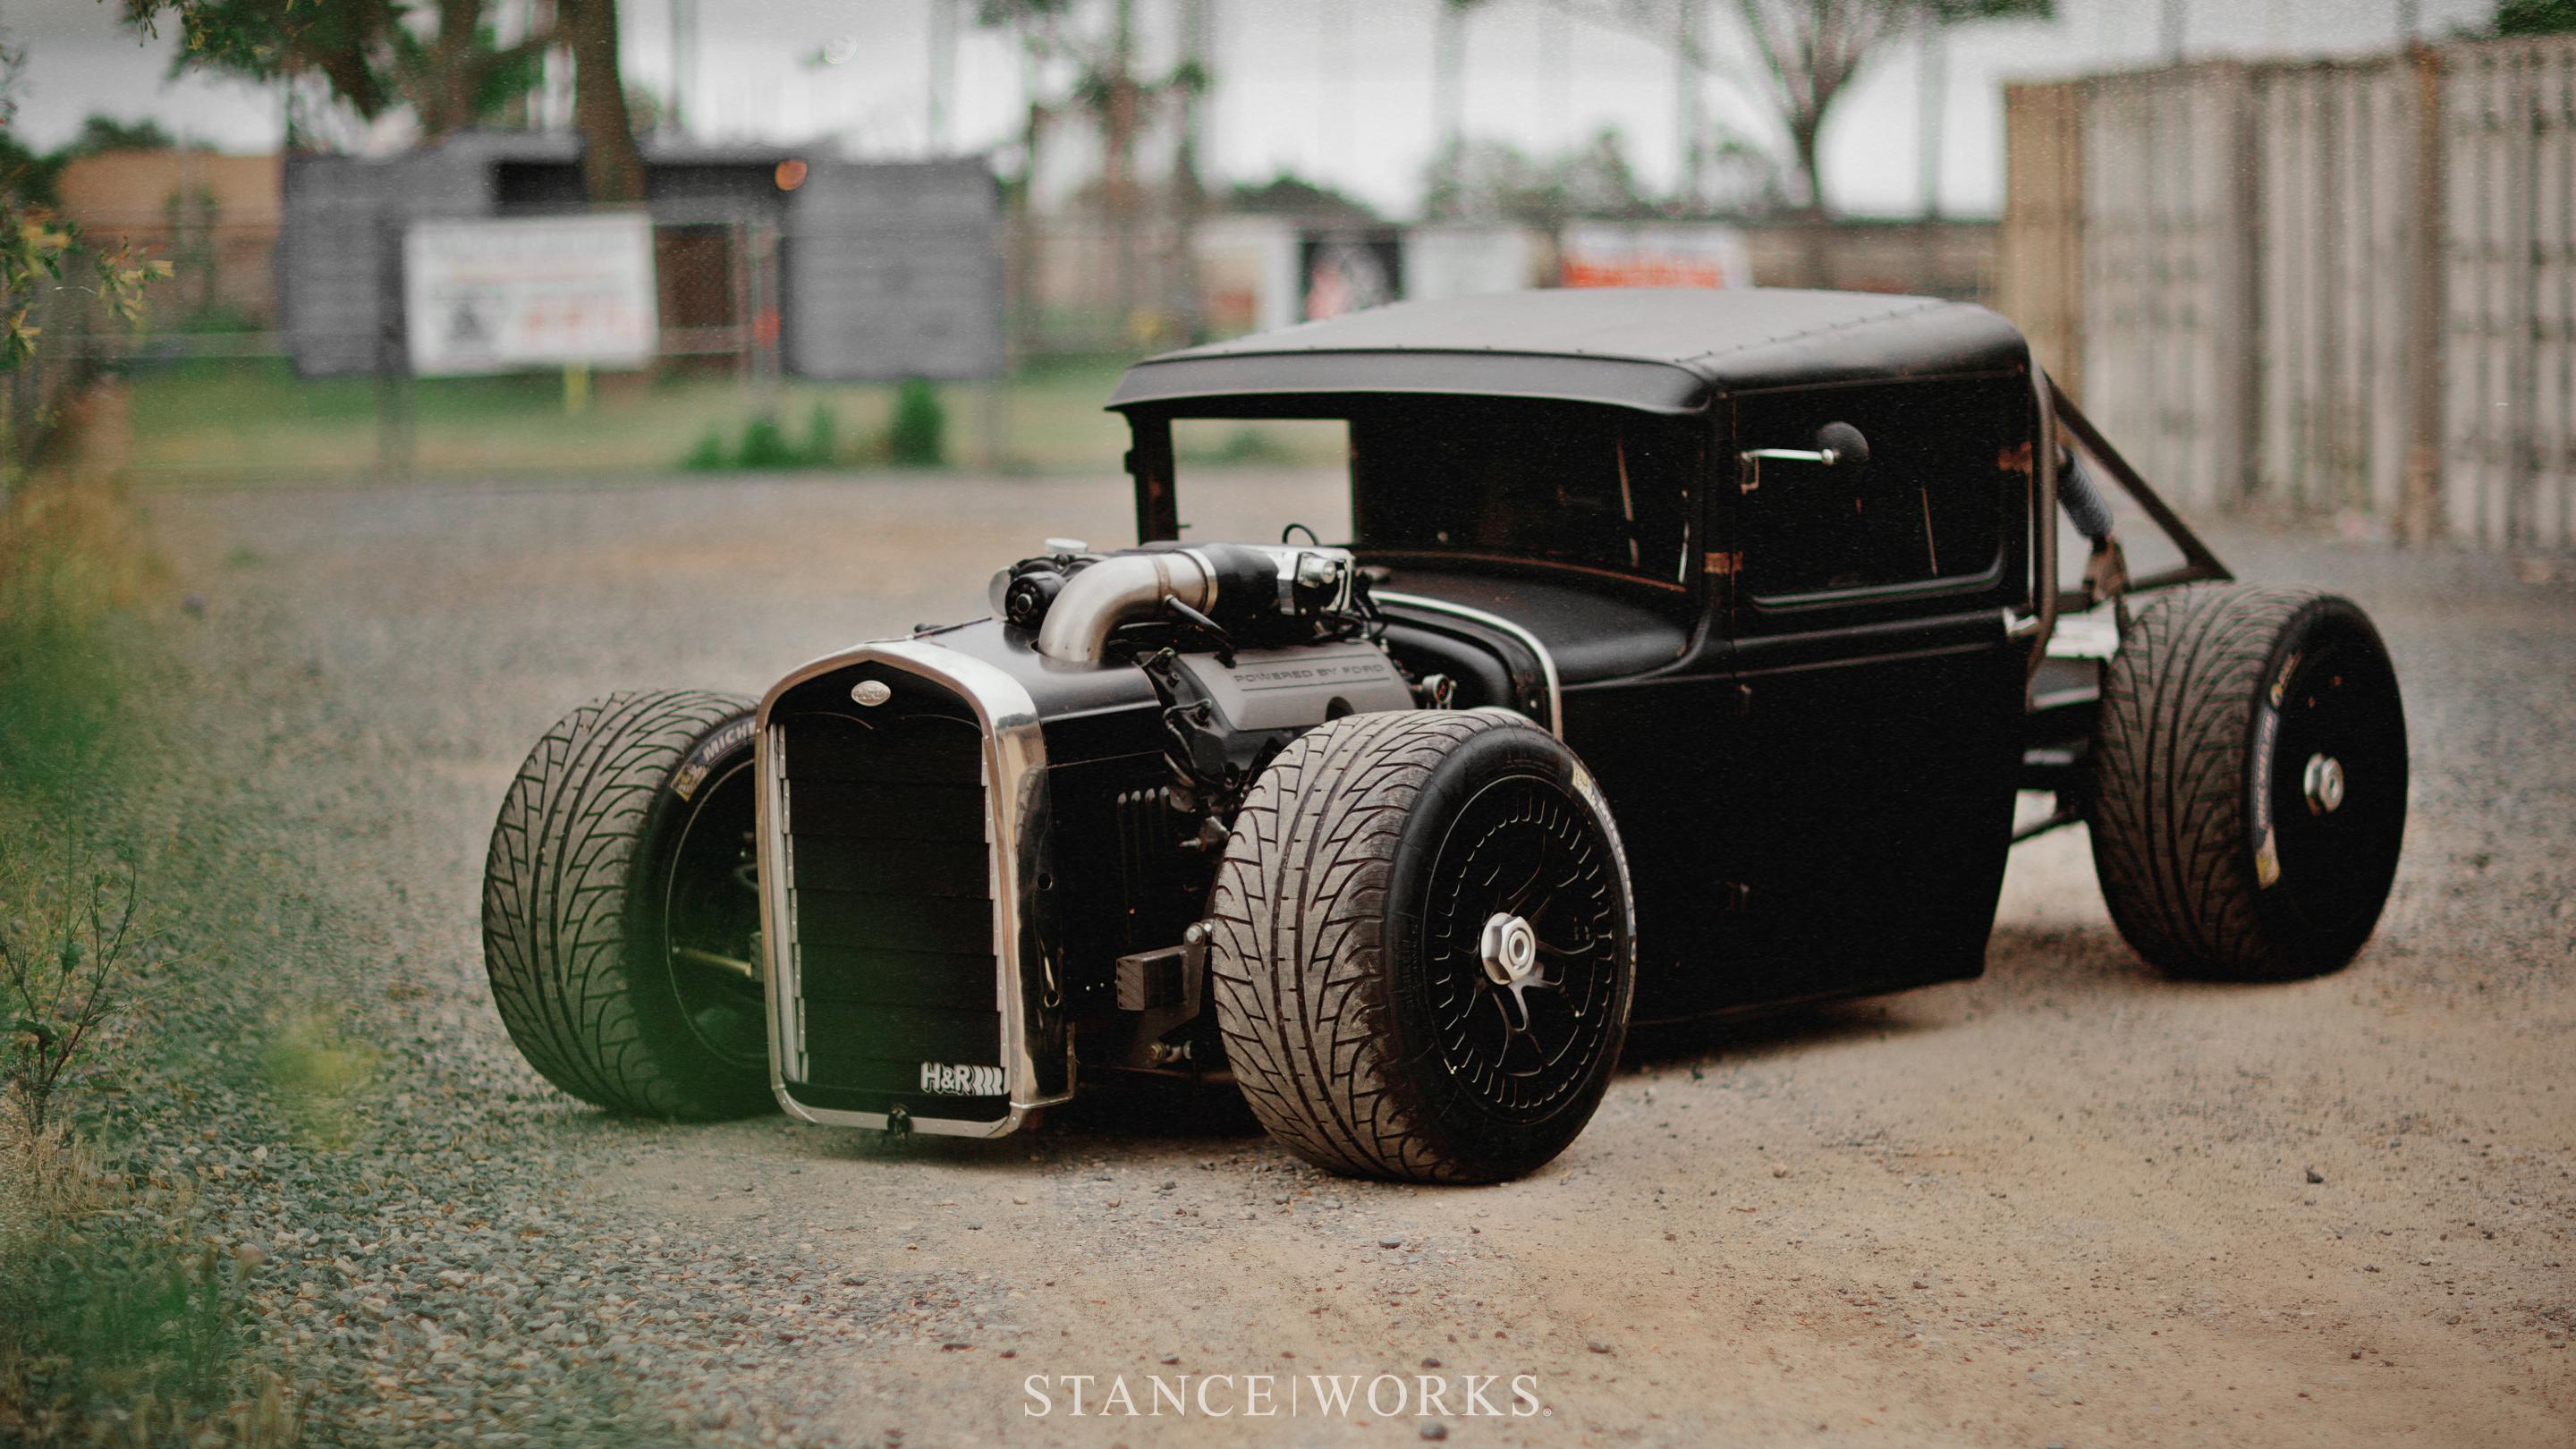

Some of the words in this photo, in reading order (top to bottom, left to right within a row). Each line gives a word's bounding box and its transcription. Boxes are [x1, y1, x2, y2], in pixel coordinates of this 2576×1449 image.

[1234, 669, 1313, 682] POWERED
[1318, 667, 1337, 677] BY
[1343, 664, 1384, 675] FORD
[921, 1062, 972, 1094] H&R
